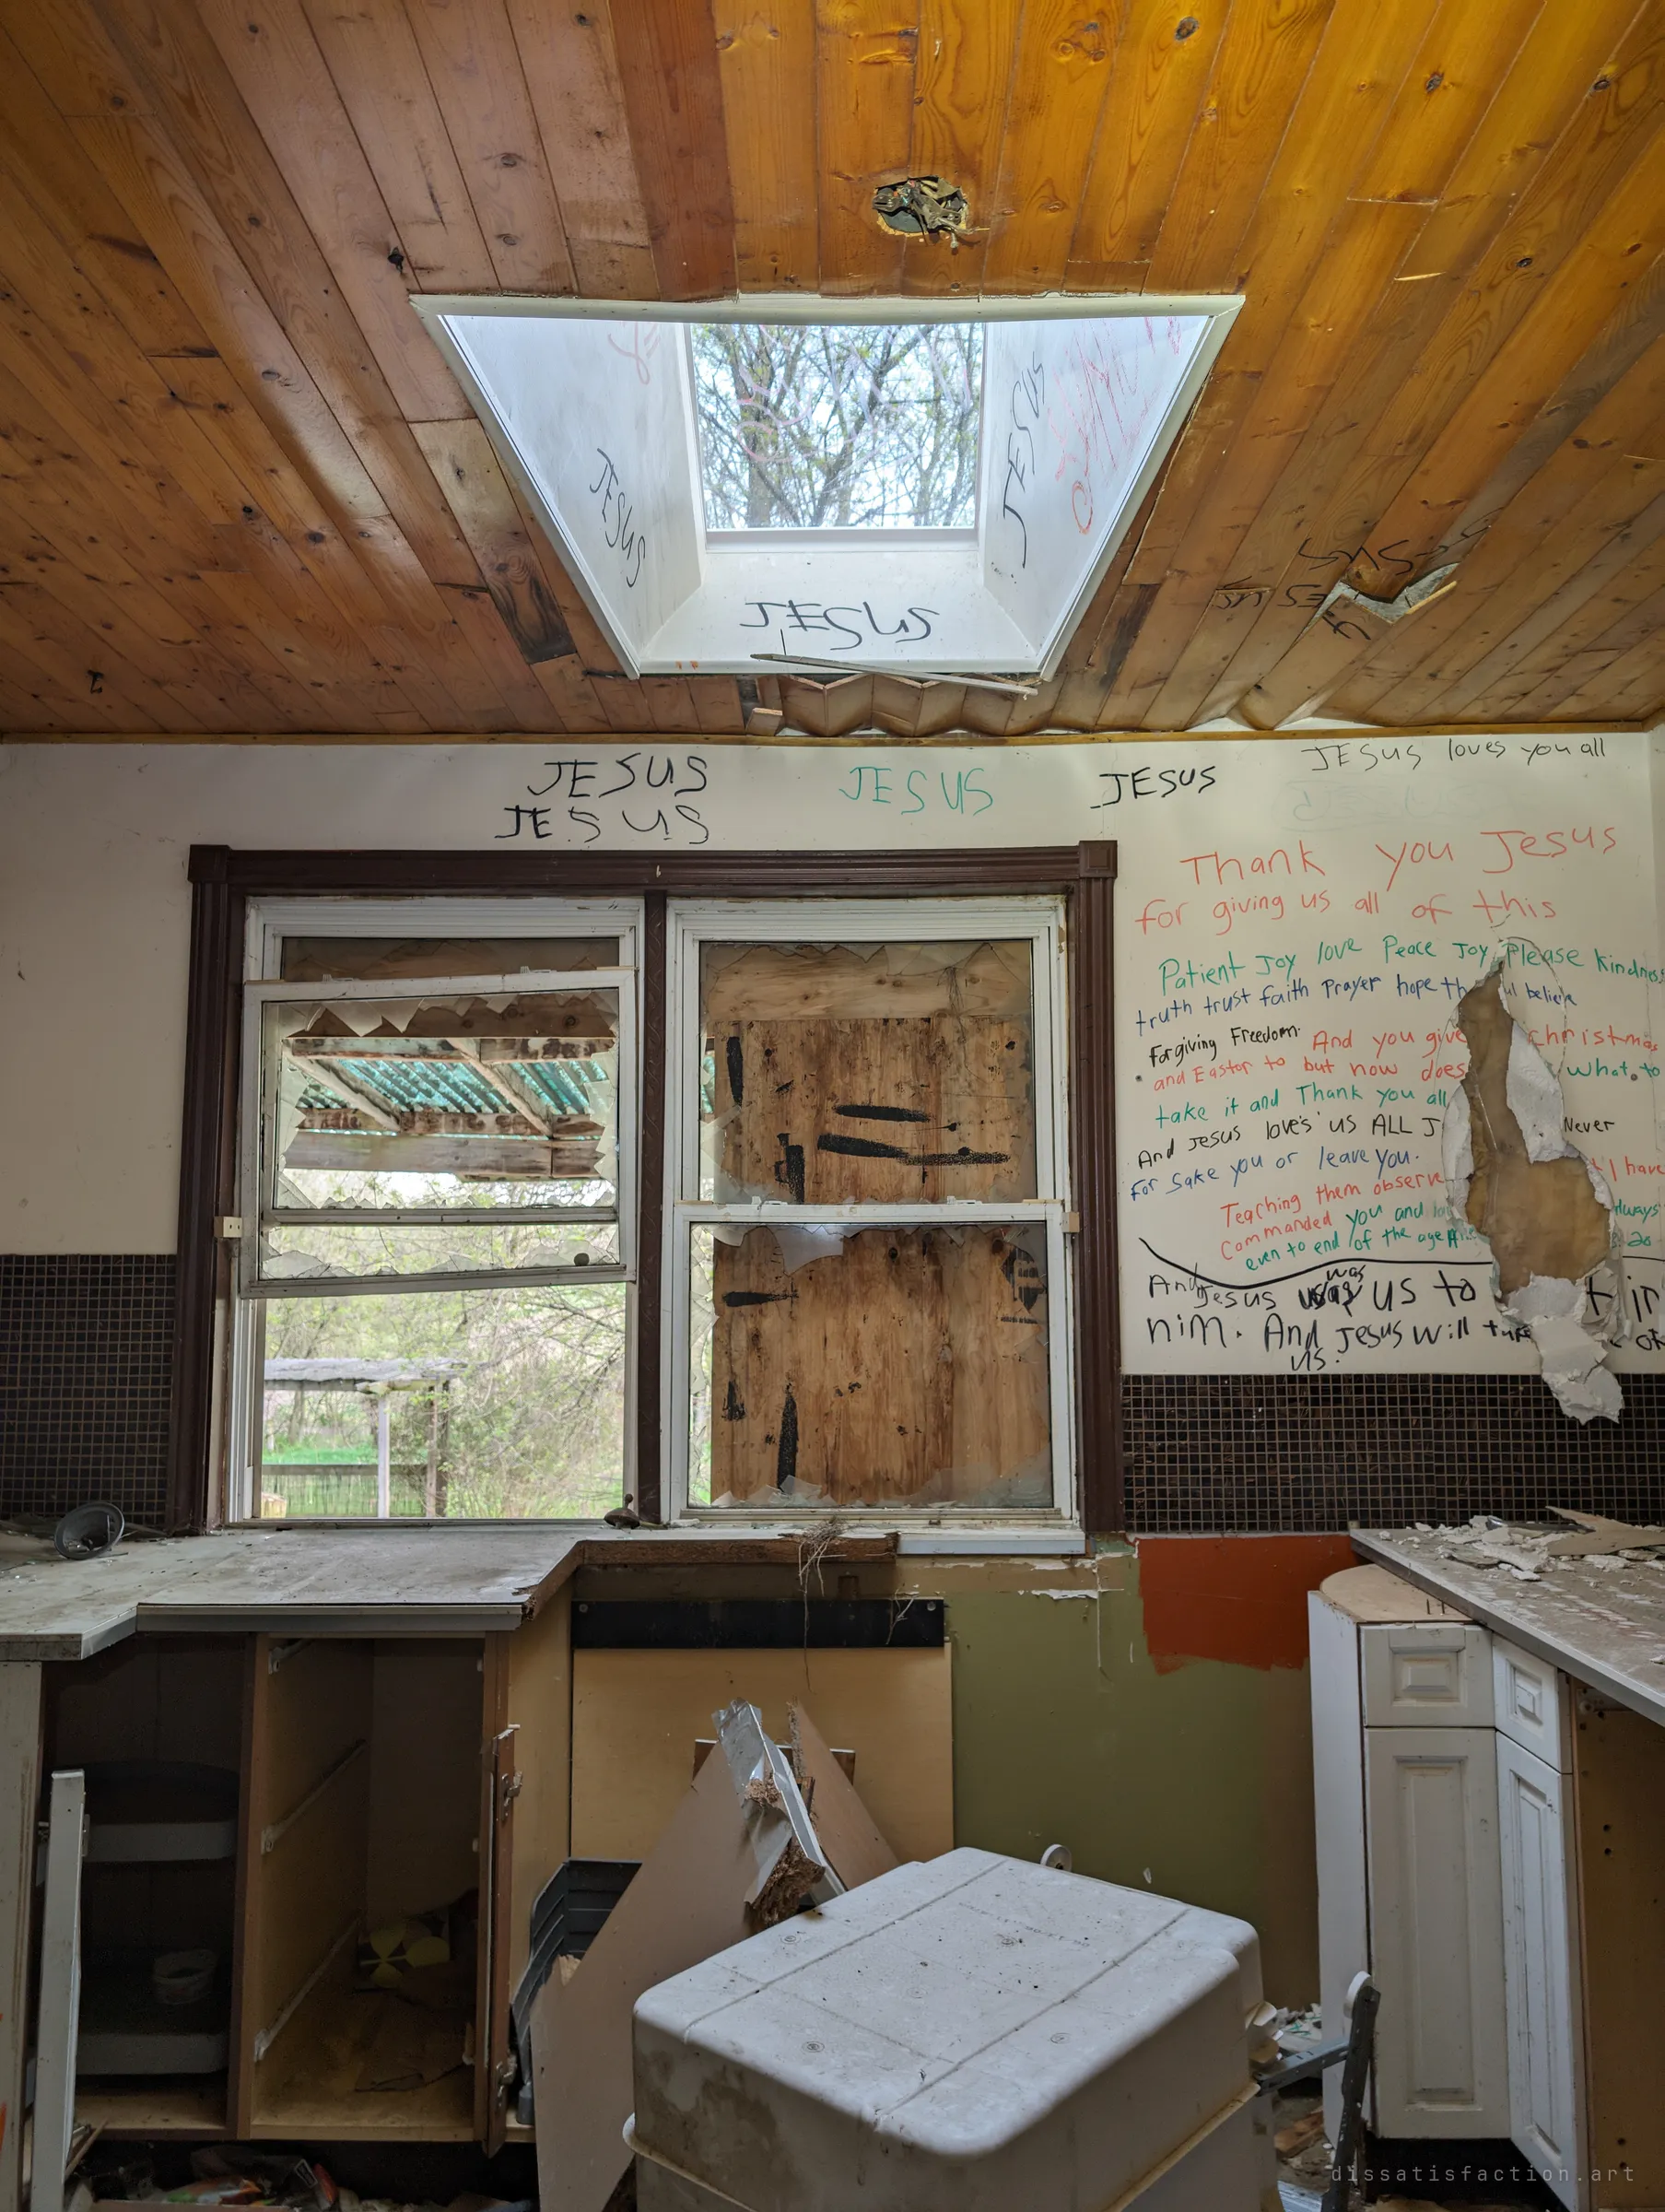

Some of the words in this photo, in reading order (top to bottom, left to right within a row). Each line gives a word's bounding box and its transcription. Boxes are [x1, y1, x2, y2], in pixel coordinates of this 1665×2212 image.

[1003, 351, 1046, 569] JESUS
[589, 448, 646, 588] JESUS
[740, 598, 941, 650] JESUS
[527, 753, 708, 797] JESUS
[1301, 743, 1422, 771] JESUS
[1448, 738, 1507, 761] loves
[1520, 743, 1571, 766] you
[1580, 737, 1605, 758] all
[839, 767, 992, 816] JESUS
[1091, 766, 1216, 809] JESUS
[495, 805, 709, 844] JESUS
[1180, 840, 1326, 885] Thank
[1376, 841, 1454, 891] you
[1480, 827, 1617, 874] Jesus
[1135, 899, 1190, 934] for
[1213, 895, 1284, 935] giving
[1301, 890, 1331, 913] us
[1354, 891, 1379, 914] all
[1412, 893, 1453, 924] of
[1473, 889, 1557, 924] this
[1159, 951, 1246, 996] Patient
[1318, 938, 1362, 965] love
[1382, 935, 1437, 964] Peace
[1505, 943, 1585, 969] Please
[1135, 999, 1192, 1037] truth
[1203, 988, 1251, 1016] trust
[1259, 978, 1308, 1006] faith
[1397, 974, 1437, 999] hope
[1313, 1030, 1353, 1054] And
[1372, 1030, 1415, 1059] you
[1154, 1069, 1186, 1091] and
[1264, 1055, 1285, 1071] to
[1304, 1056, 1335, 1074] but
[1350, 1062, 1399, 1077] now
[1639, 1062, 1660, 1077] to
[1155, 1102, 1209, 1129] take
[1225, 1097, 1239, 1117] it
[1249, 1088, 1279, 1112] and
[1296, 1082, 1364, 1105] Thank
[1377, 1086, 1415, 1108] you
[1426, 1089, 1447, 1107] all
[1138, 1137, 1175, 1170] And
[1189, 1125, 1241, 1152] Jesus
[1372, 1113, 1413, 1135] ALL
[1230, 1155, 1262, 1187] you
[1276, 1152, 1298, 1170] or
[1319, 1146, 1369, 1170] leave
[1220, 1194, 1301, 1228] Teaching
[1316, 1185, 1361, 1206] them
[1346, 1204, 1382, 1248] you
[1395, 1202, 1424, 1222] and
[1246, 1248, 1281, 1272] even
[1287, 1239, 1306, 1258] to
[1314, 1230, 1340, 1255] end
[1354, 1230, 1372, 1252] of
[1382, 1226, 1411, 1245] the
[1149, 1262, 1201, 1298] And
[1193, 1284, 1277, 1311] Jesus
[1373, 1279, 1416, 1312] us
[1434, 1270, 1477, 1307] to
[1327, 1264, 1366, 1282] was
[1264, 1312, 1319, 1352] And
[1336, 1318, 1402, 1353] Jesus
[1413, 1316, 1469, 1345] will
